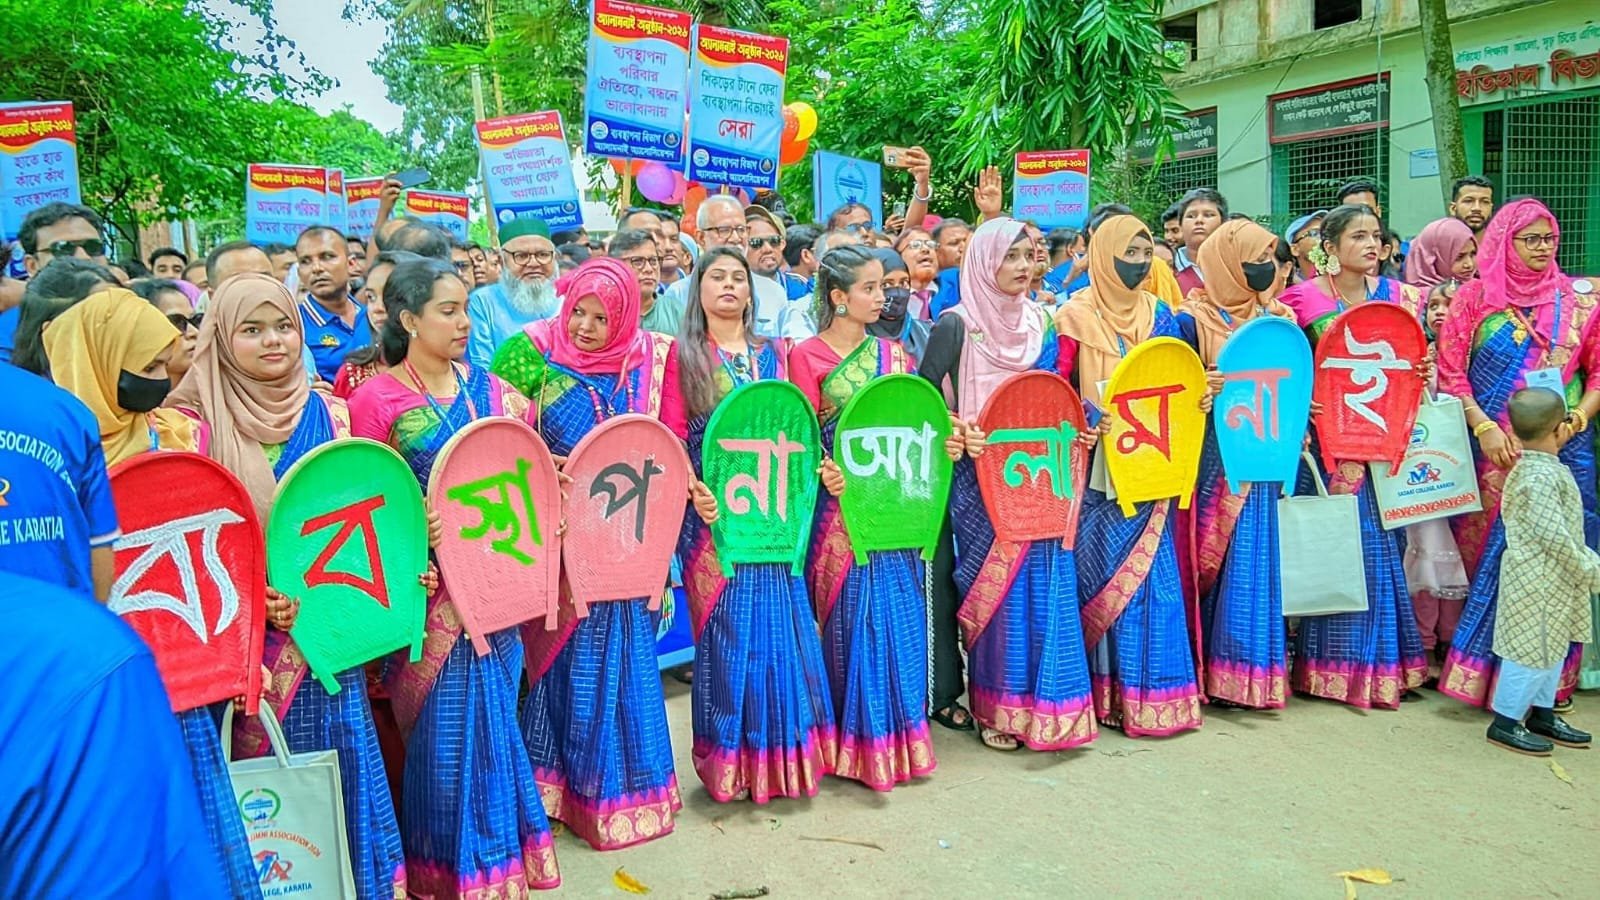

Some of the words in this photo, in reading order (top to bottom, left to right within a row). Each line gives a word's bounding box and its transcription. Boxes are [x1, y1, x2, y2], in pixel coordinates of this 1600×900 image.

[613, 45, 667, 67] ব্যবস্থাপনা
[619, 64, 659, 84] পরিবার
[1456, 64, 1541, 98] ইতিহাস
[1547, 49, 1600, 84] বিভ
[647, 86, 679, 102] বন্ধনে
[701, 69, 735, 92] শিকড়ের
[737, 75, 757, 94] টানে
[758, 81, 779, 97] ফেরা
[605, 99, 669, 119] ভালোবাসায়
[702, 93, 742, 115] ব্যবস্থাপনা
[744, 97, 775, 117] বিভাগই
[610, 128, 641, 142] ব্যবস্থাপনা
[642, 130, 661, 144] বিভাগ
[718, 118, 755, 141] সেরা
[711, 156, 739, 170] ব্যবস্থাপনা
[740, 157, 758, 170] বিভাগ
[1320, 322, 1413, 434] ই
[1223, 368, 1291, 442] না
[1110, 384, 1187, 463] ম
[0, 429, 64, 473] SOCIATION
[841, 420, 938, 484] অ্যা
[984, 419, 1080, 500] লা
[717, 431, 806, 523] না
[447, 457, 543, 566] স্থা
[590, 453, 666, 544] প
[13, 516, 65, 544] KARATIA
[300, 494, 391, 609] ব
[263, 887, 283, 898] LEGE,
[284, 882, 312, 894] KARATIA
